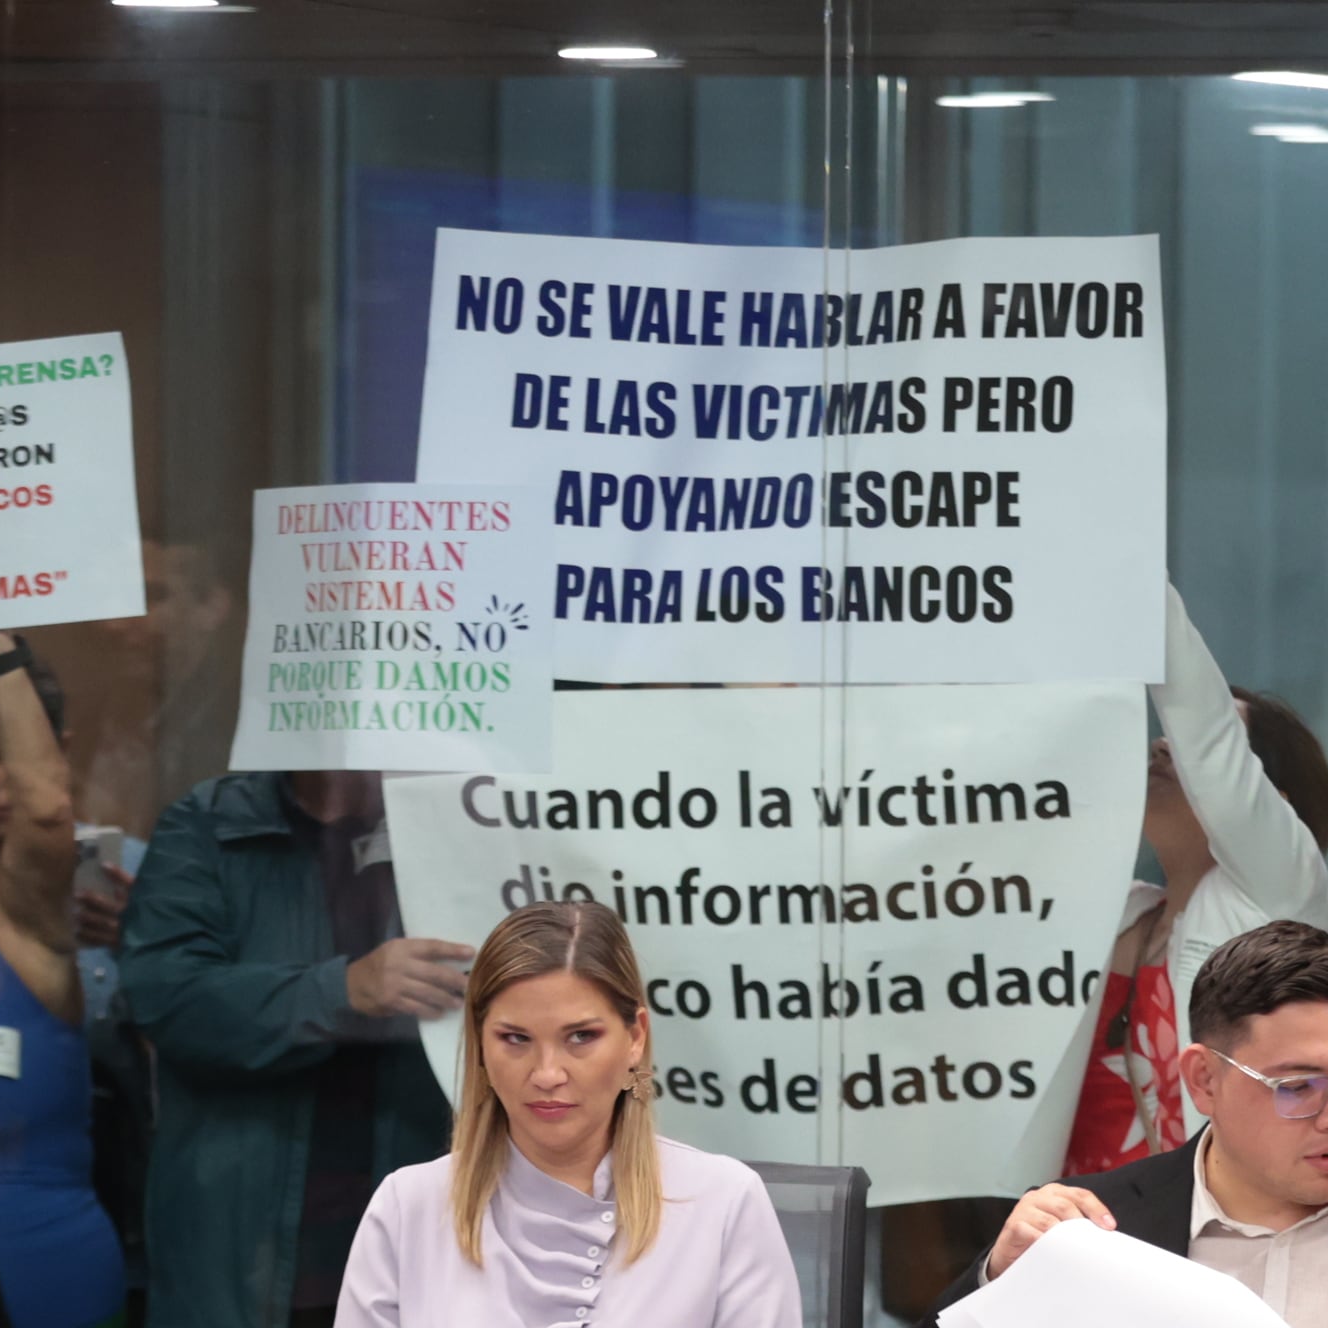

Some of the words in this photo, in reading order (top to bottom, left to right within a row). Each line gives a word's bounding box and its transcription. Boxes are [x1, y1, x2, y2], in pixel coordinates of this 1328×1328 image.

[455, 275, 524, 334] NO
[536, 280, 595, 338] SE
[608, 284, 727, 346] VALE
[739, 287, 924, 349] HABLAR
[933, 283, 966, 338] A
[981, 281, 1143, 339] FAVOR
[510, 372, 571, 431] DE
[584, 377, 677, 439] LAS
[692, 376, 926, 441] VICTIMAS
[942, 375, 1074, 433] PERO
[277, 501, 511, 535] DELINCUENTES
[554, 470, 814, 532] APOYANDO
[828, 470, 1020, 528] ESCAPE
[300, 541, 468, 573] VULNERAN
[304, 581, 456, 613] SISTEMAS
[554, 563, 683, 624] PARA
[695, 565, 785, 623] LOS
[801, 565, 1013, 623] BANCOS
[272, 620, 443, 658] BANCARIOS,
[456, 621, 507, 653] NO
[267, 660, 363, 698] PORQUE
[376, 661, 511, 692] DAMOS
[267, 692, 495, 733] INFORMACIÓN.
[461, 771, 717, 830] Cuando
[738, 770, 793, 828] la
[812, 768, 1071, 828] víctima
[612, 862, 1055, 926] información,
[730, 960, 925, 1020] había
[740, 1057, 820, 1114] de
[841, 1053, 1037, 1111] datos
